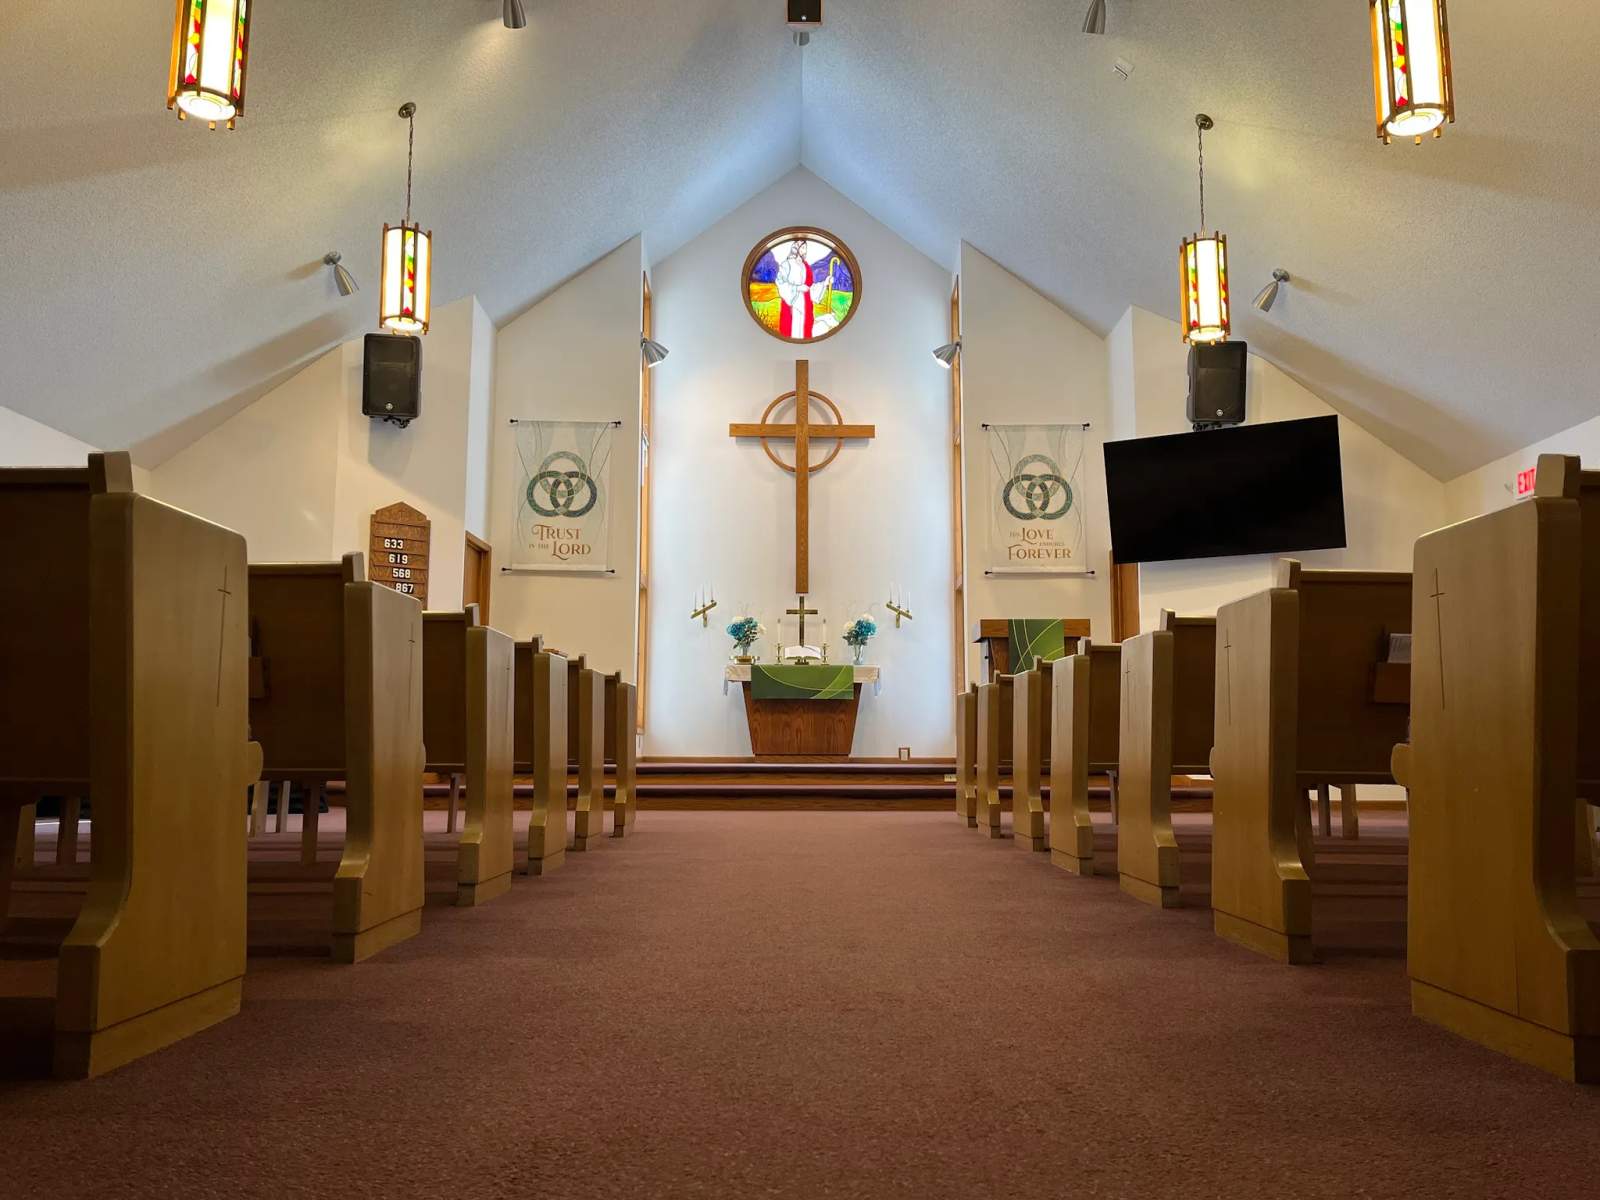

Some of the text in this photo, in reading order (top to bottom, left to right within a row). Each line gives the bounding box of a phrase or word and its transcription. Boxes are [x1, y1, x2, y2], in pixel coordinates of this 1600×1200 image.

[1517, 467, 1536, 494] EXIT
[532, 524, 581, 540] TRUST
[1021, 527, 1054, 544] LOVE
[384, 538, 404, 549] 633
[552, 541, 591, 560] LORD
[388, 553, 408, 564] 619
[1008, 544, 1071, 560] FOREVER
[392, 567, 411, 578] 568
[395, 583, 414, 593] 867
